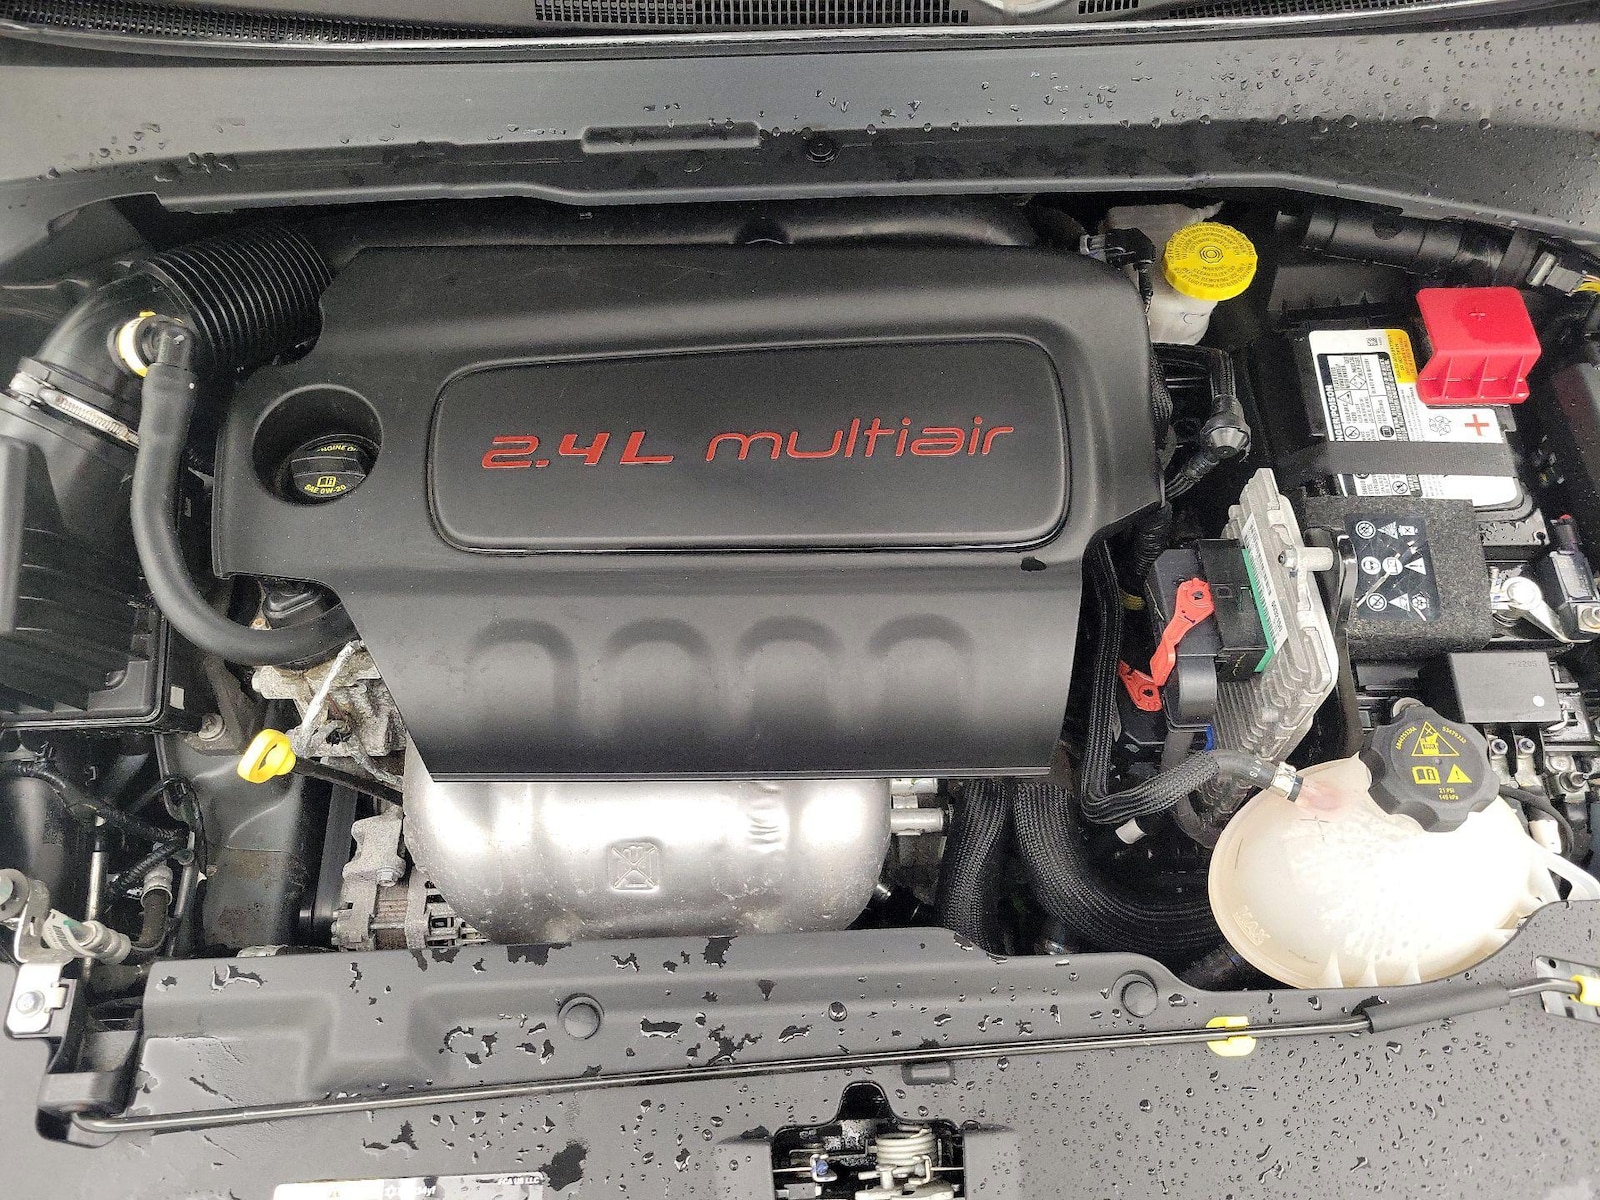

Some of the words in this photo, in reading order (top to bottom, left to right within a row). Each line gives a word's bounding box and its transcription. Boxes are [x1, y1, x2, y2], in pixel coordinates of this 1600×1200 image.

[1325, 384, 1345, 441] NGER/POISON
[317, 444, 346, 452] NGINE
[705, 416, 1014, 462] multiair
[304, 484, 319, 494] SAE
